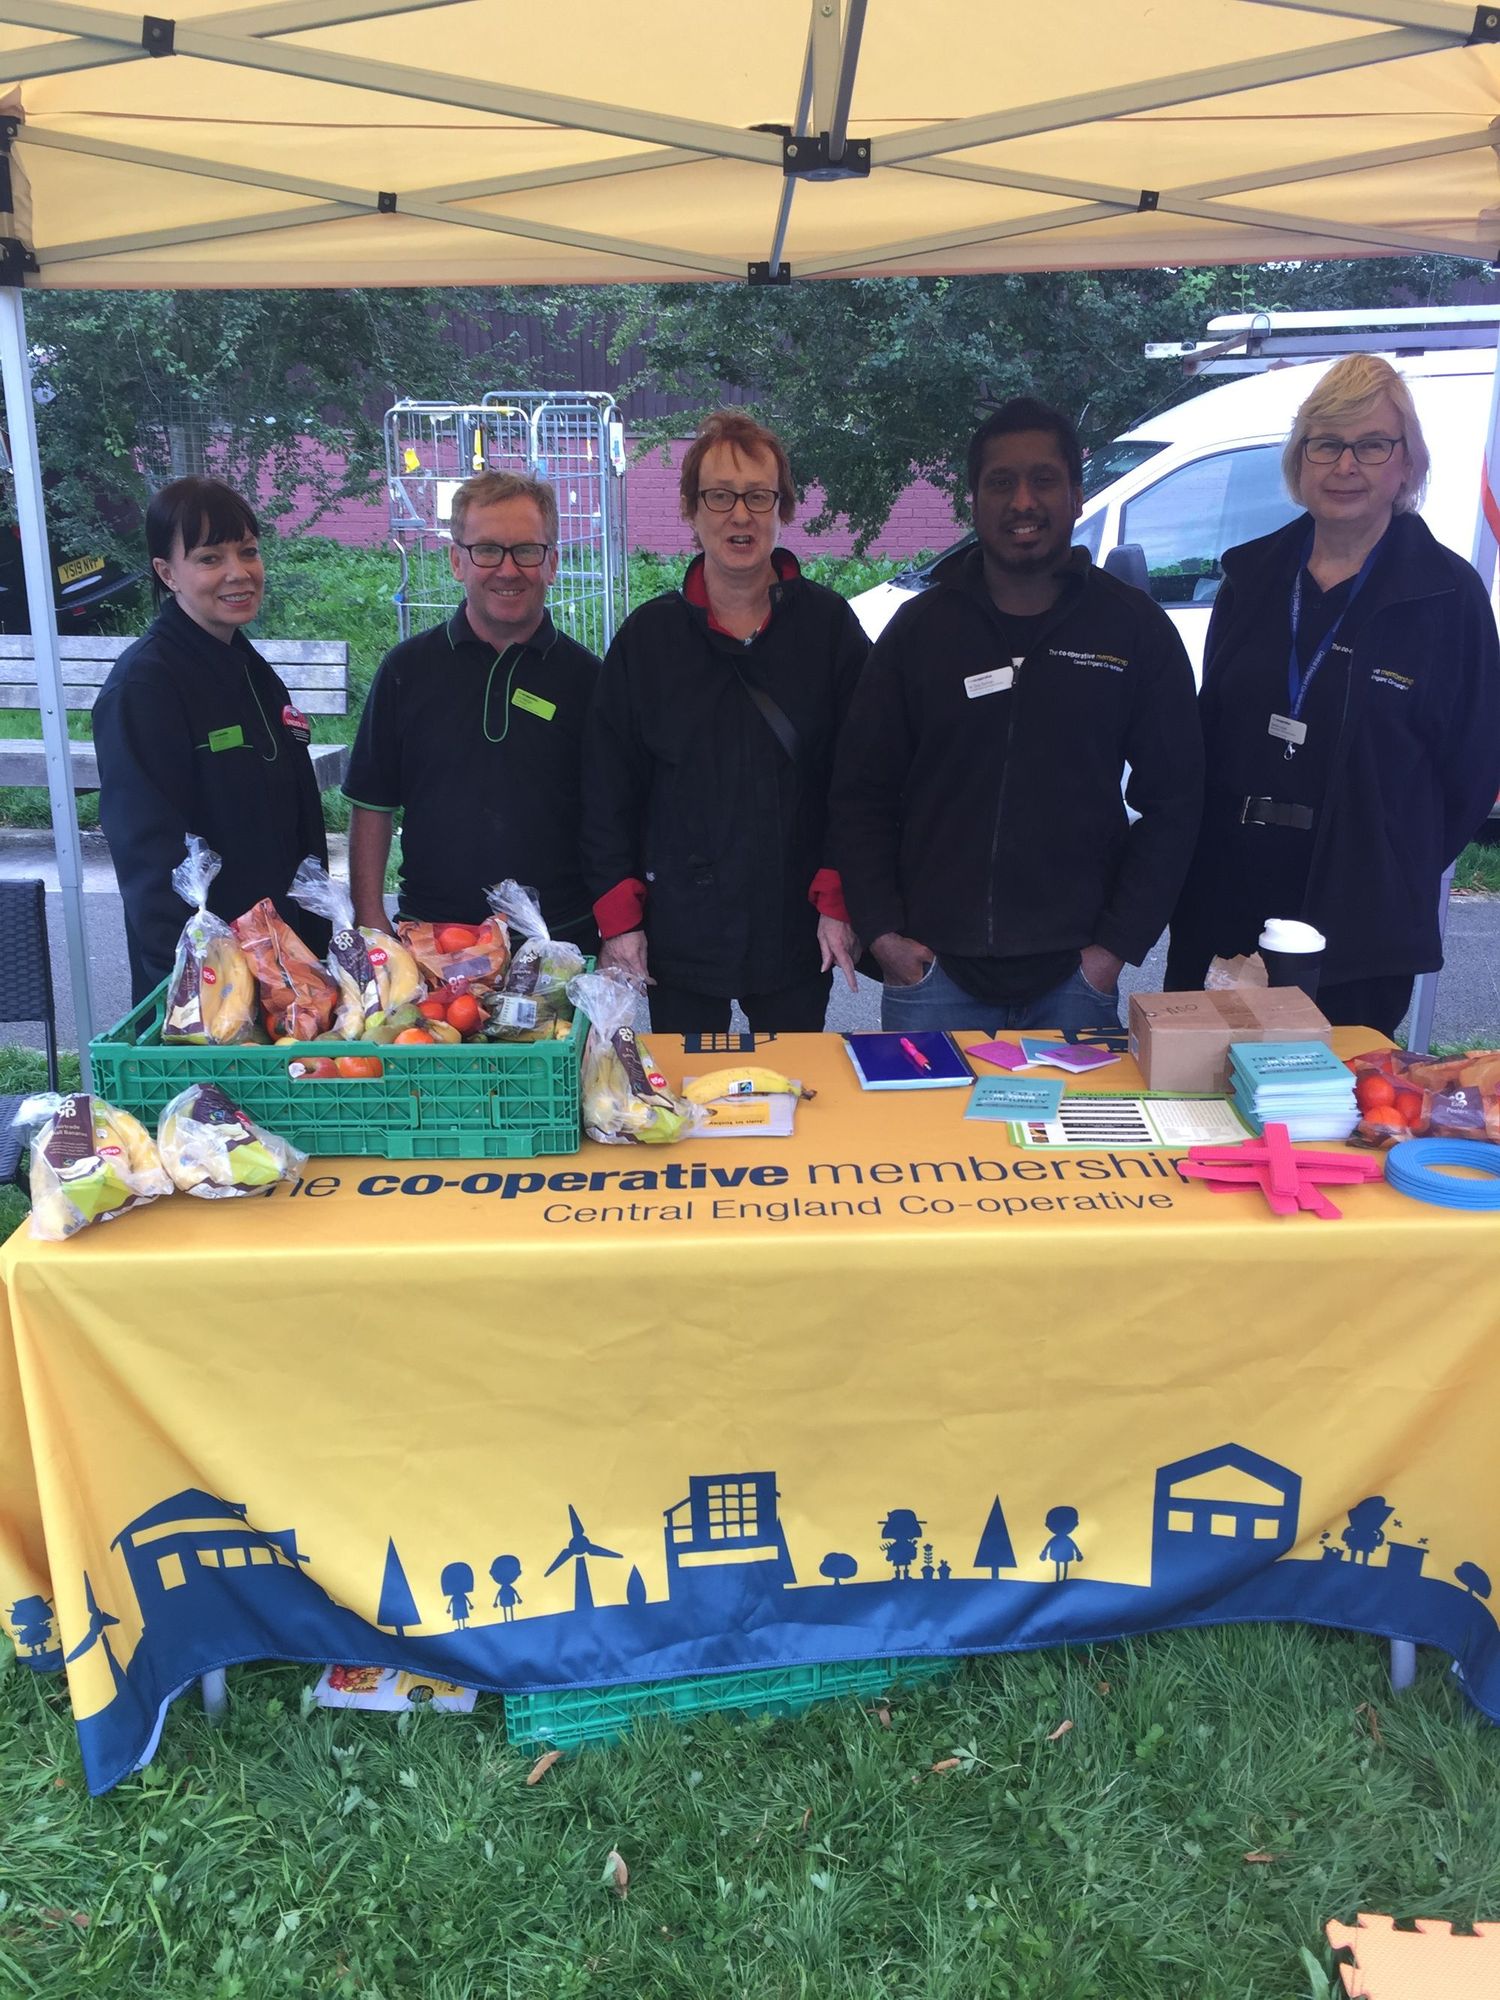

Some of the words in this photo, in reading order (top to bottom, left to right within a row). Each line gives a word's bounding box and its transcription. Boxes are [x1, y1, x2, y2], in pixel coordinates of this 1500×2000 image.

[357, 1163, 789, 1199] co-operative
[543, 1201, 693, 1223] Central
[712, 1197, 882, 1222] England
[899, 1191, 1174, 1216] Co-operative
